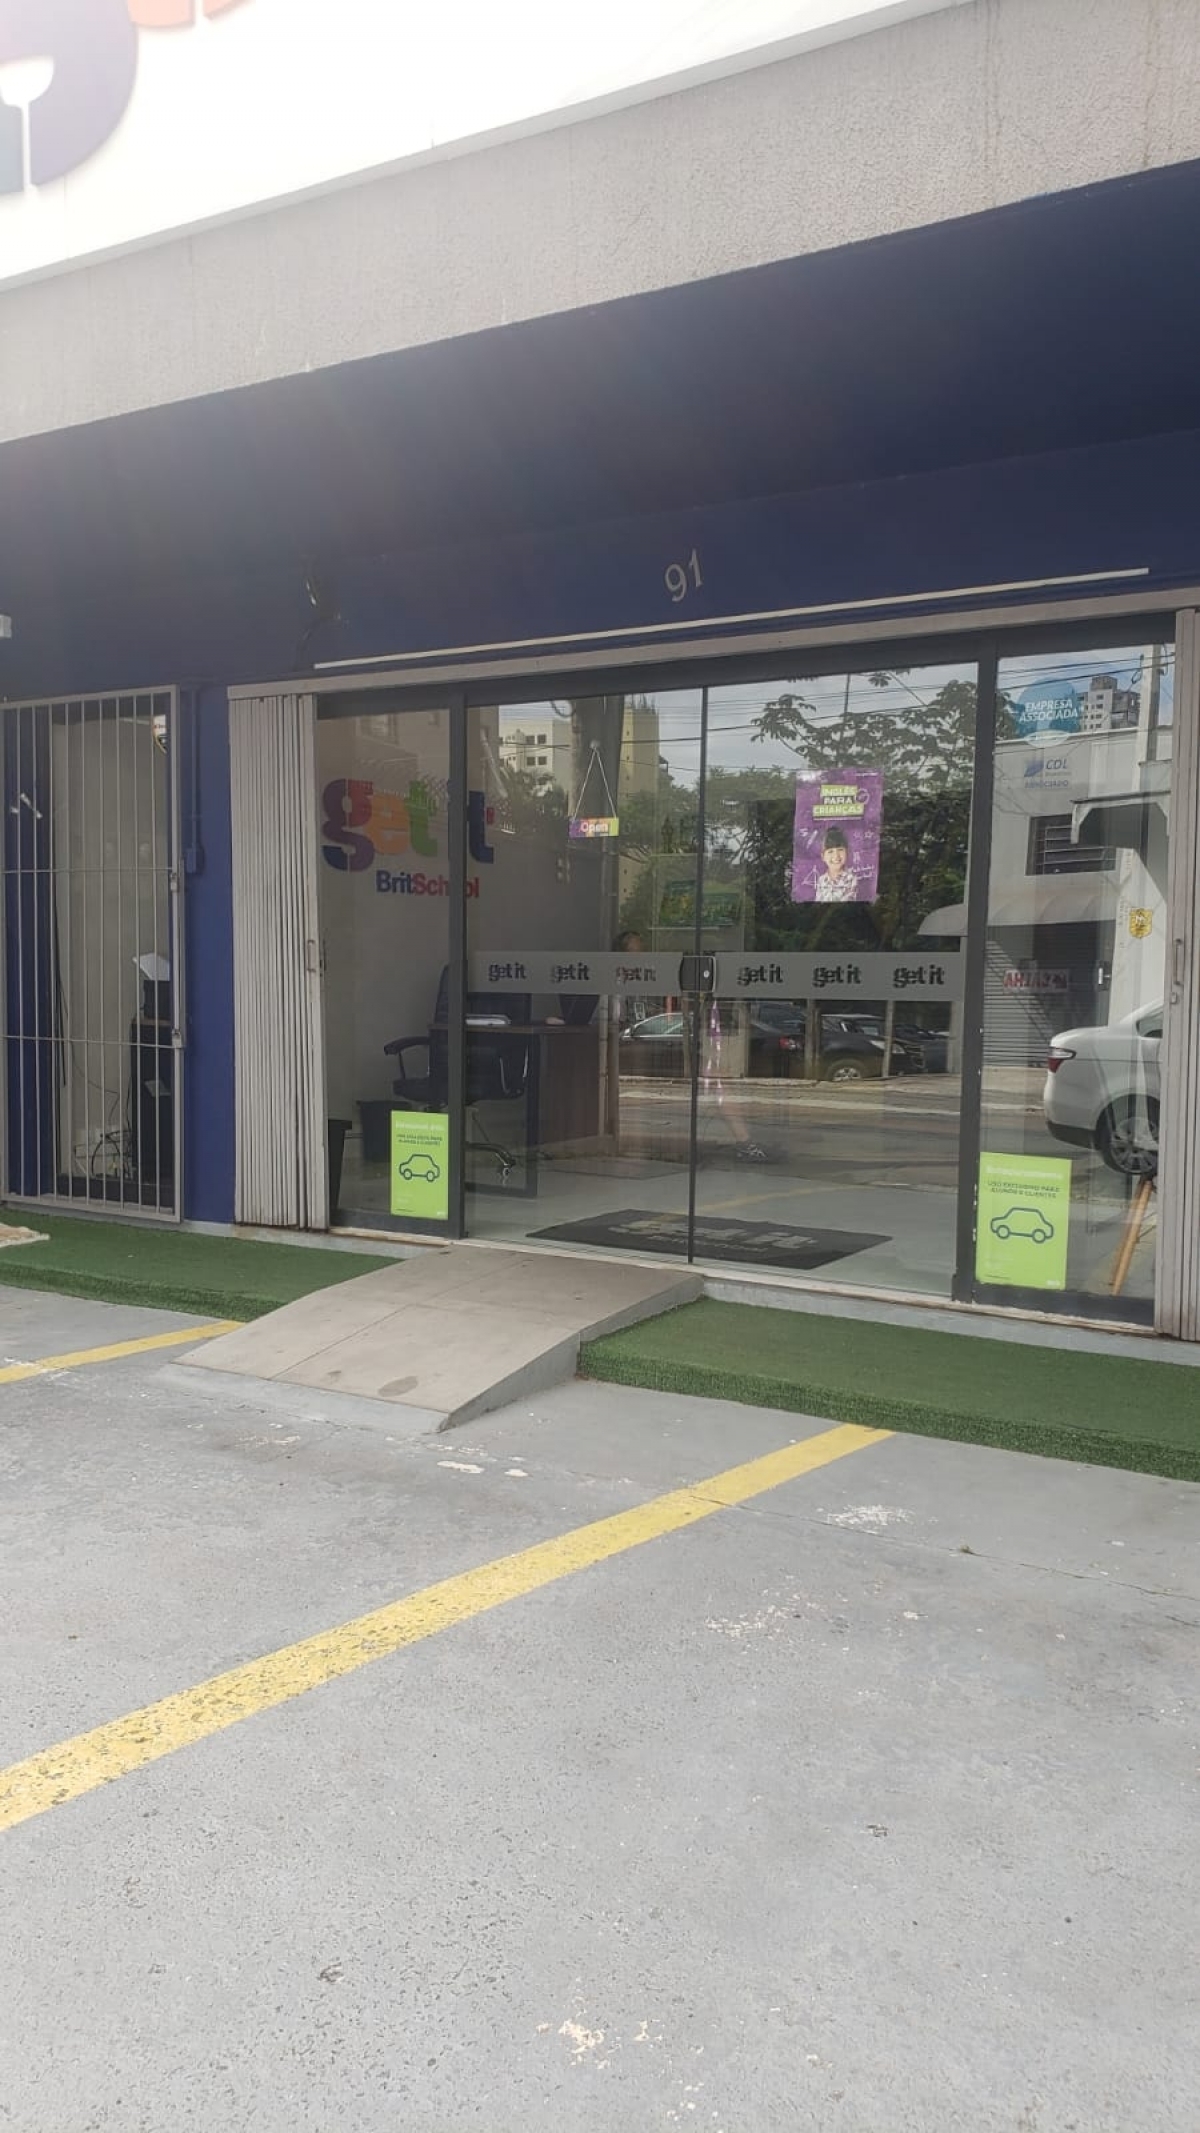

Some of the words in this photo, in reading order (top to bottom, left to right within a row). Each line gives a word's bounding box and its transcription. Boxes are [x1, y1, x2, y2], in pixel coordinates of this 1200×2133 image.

[664, 548, 703, 602] 91
[1025, 698, 1073, 712] EMPRESA
[1019, 708, 1079, 722] ASSOCIADA
[1046, 758, 1068, 770] CDL
[824, 796, 853, 805] PARA
[580, 821, 609, 837] Open
[376, 870, 480, 898] BritSchol
